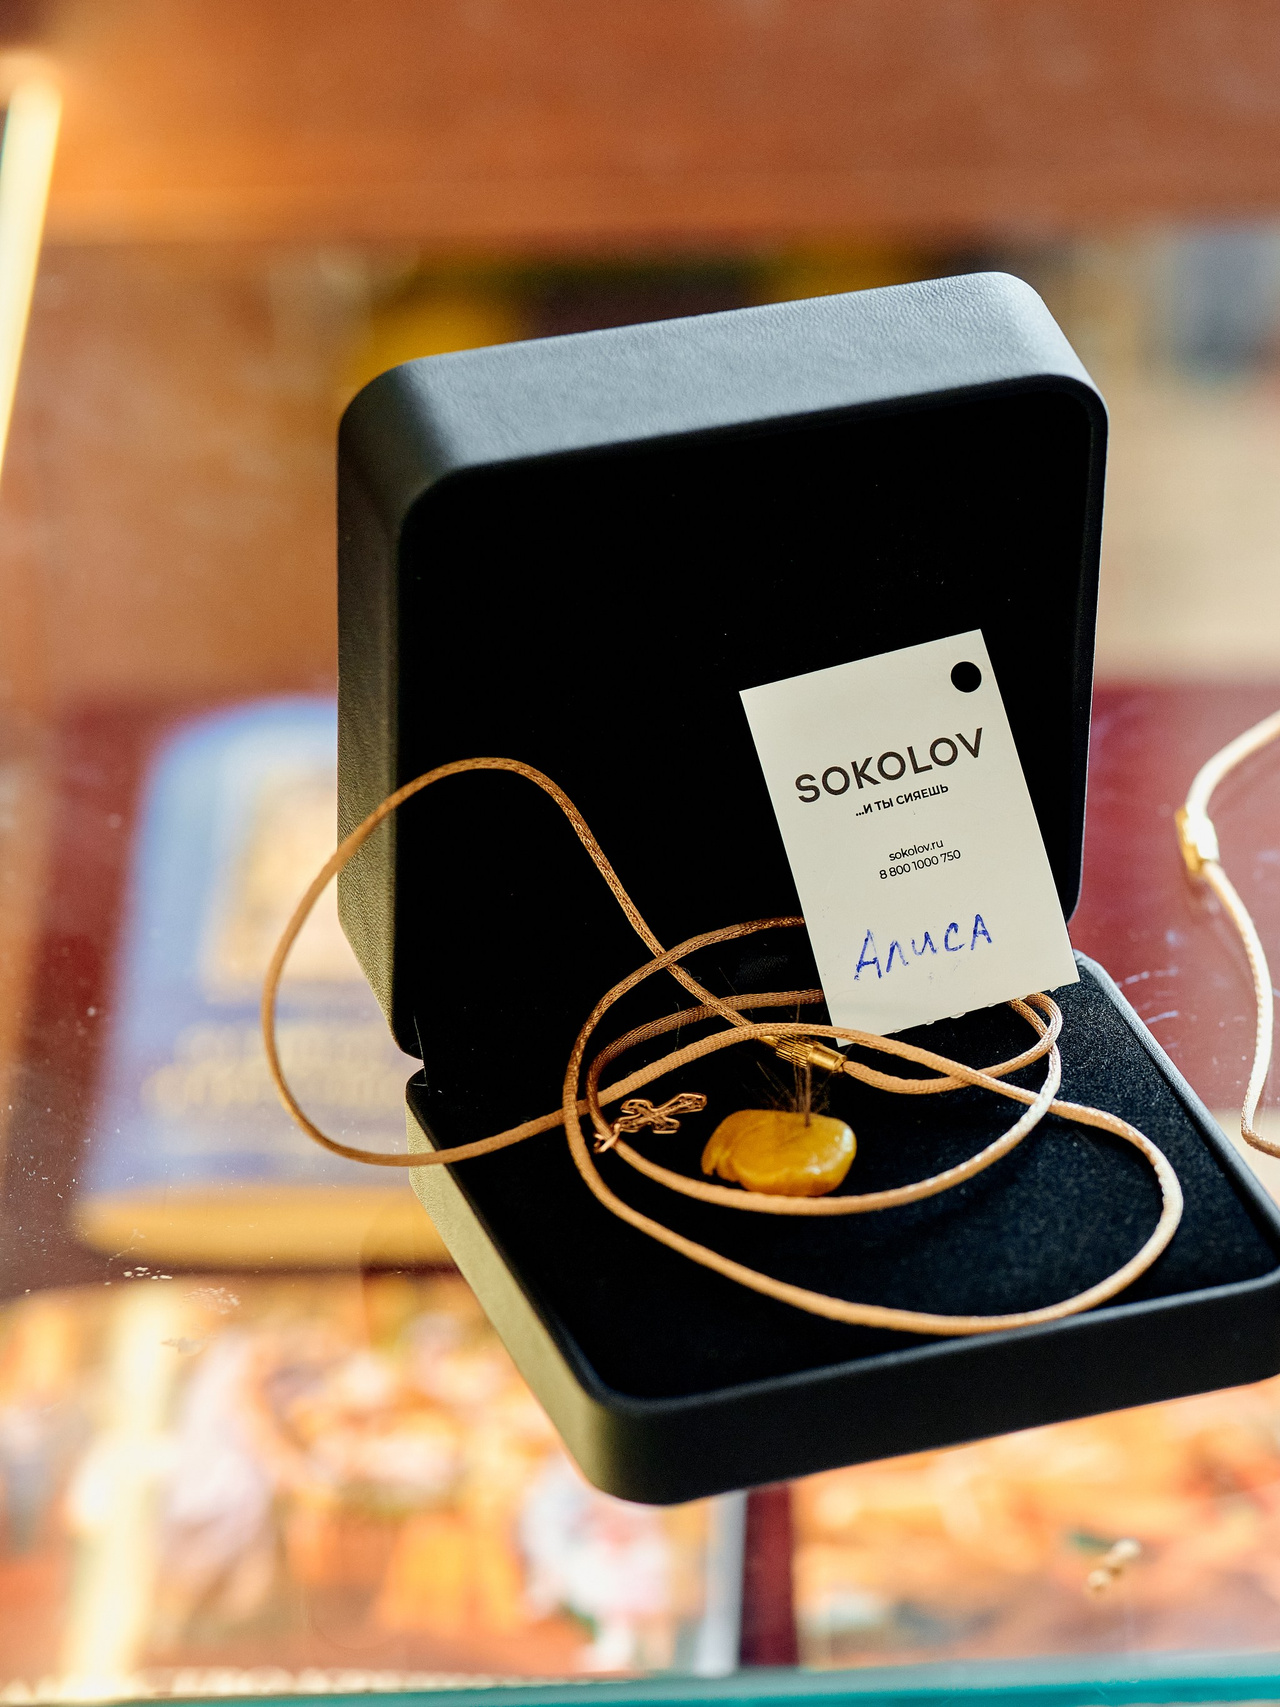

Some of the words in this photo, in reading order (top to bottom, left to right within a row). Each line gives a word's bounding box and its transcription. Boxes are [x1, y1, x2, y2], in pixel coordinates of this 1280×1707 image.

[795, 727, 983, 803] SOKOLOV
[874, 797, 894, 811] ТЫ
[895, 783, 949, 805] СИЯЕШЬ
[879, 869, 888, 880] 8
[888, 863, 911, 877] 800
[911, 855, 939, 871] 1000
[940, 849, 961, 863] 750
[888, 839, 944, 862] sokolov.ru
